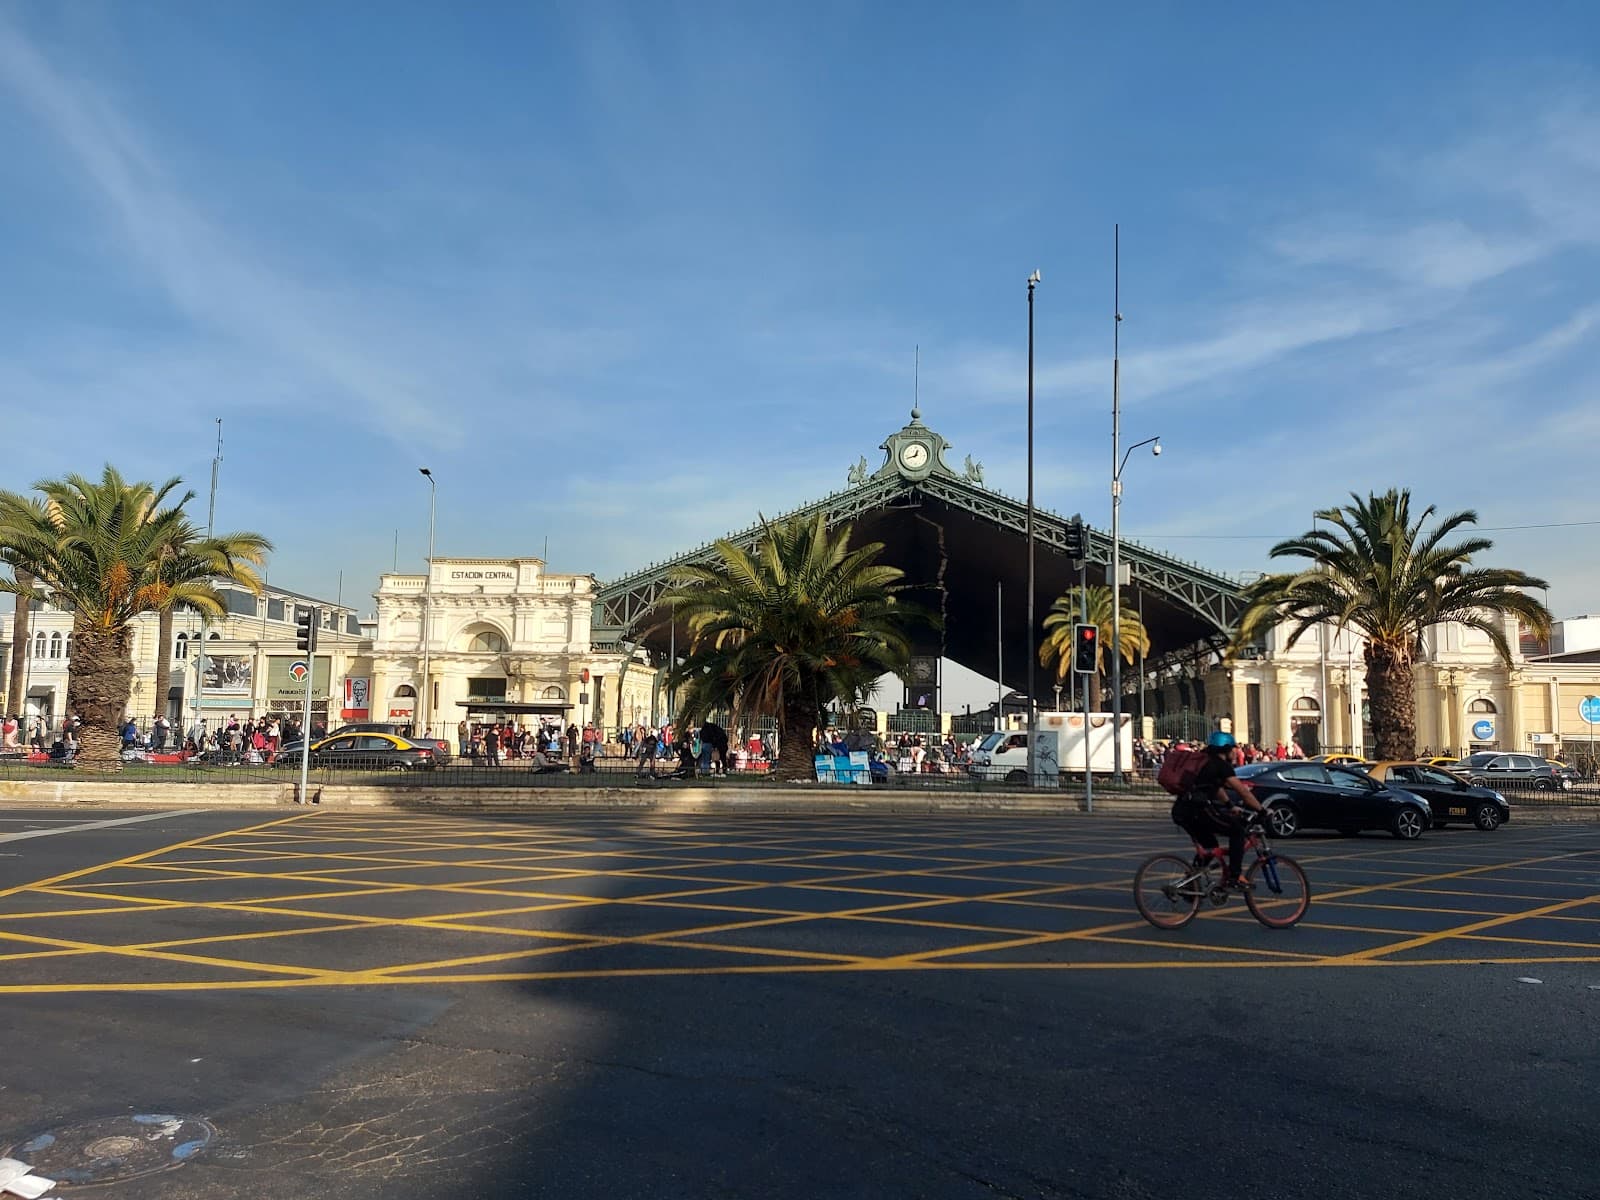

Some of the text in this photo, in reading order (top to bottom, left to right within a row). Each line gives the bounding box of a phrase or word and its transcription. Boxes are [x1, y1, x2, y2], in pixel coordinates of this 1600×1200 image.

[451, 571, 515, 579] ESTACION CENTRAL
[389, 709, 413, 718] KFC
